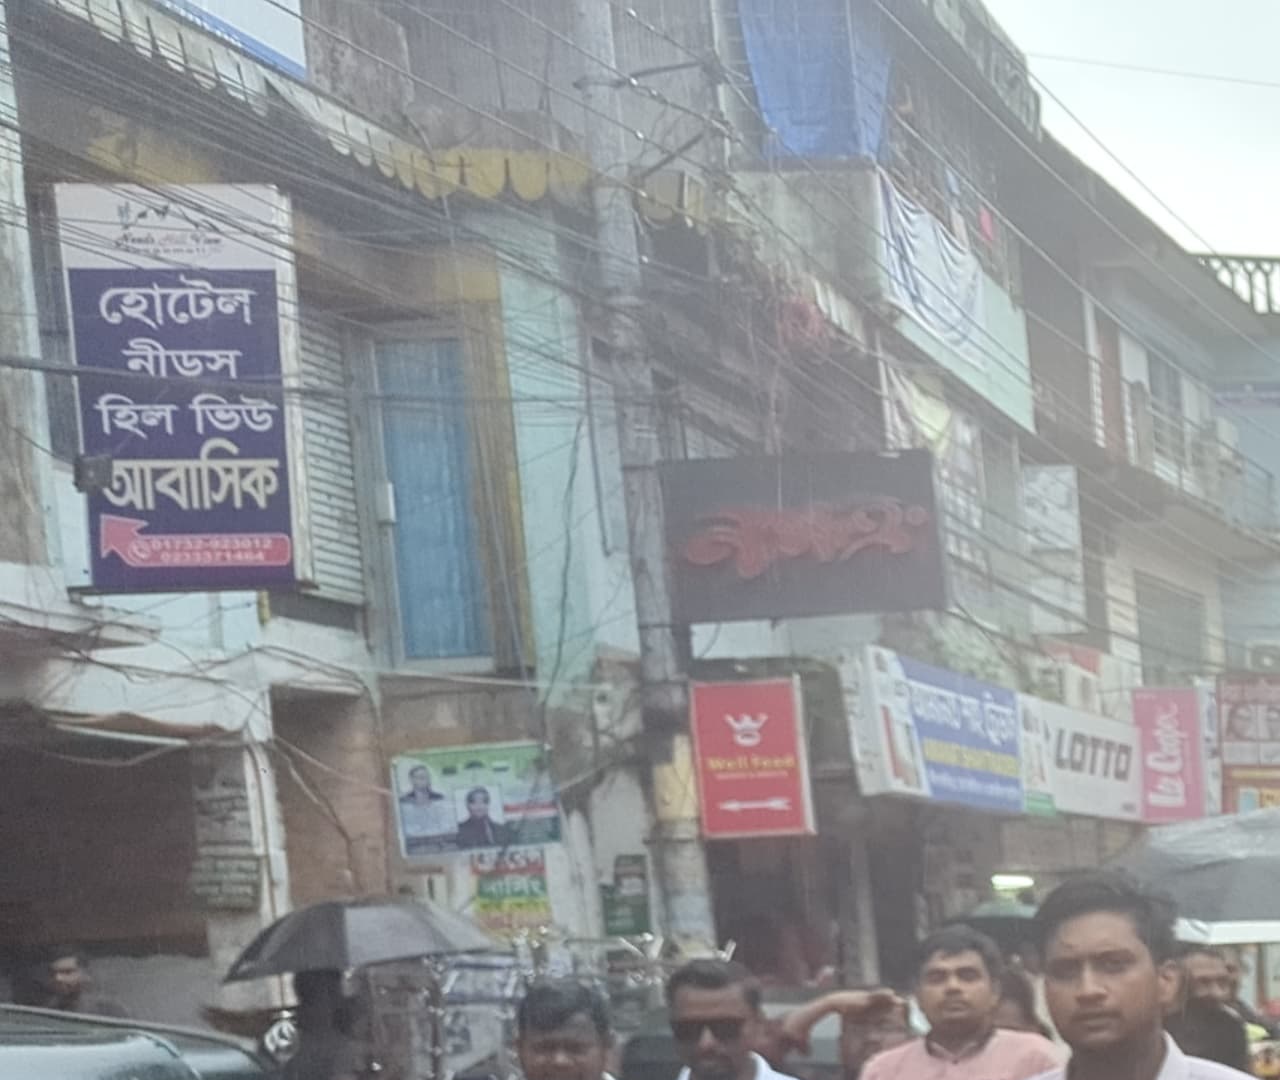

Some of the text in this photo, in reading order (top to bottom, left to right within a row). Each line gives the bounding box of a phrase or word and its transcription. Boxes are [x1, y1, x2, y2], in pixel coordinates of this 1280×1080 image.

[99, 274, 257, 330] হোটেল
[121, 337, 243, 378] নীডস
[93, 393, 279, 439] হিল ভিউ
[103, 437, 281, 511] আবাসিক
[709, 757, 748, 770] Well
[1055, 727, 1133, 772] LOTTO
